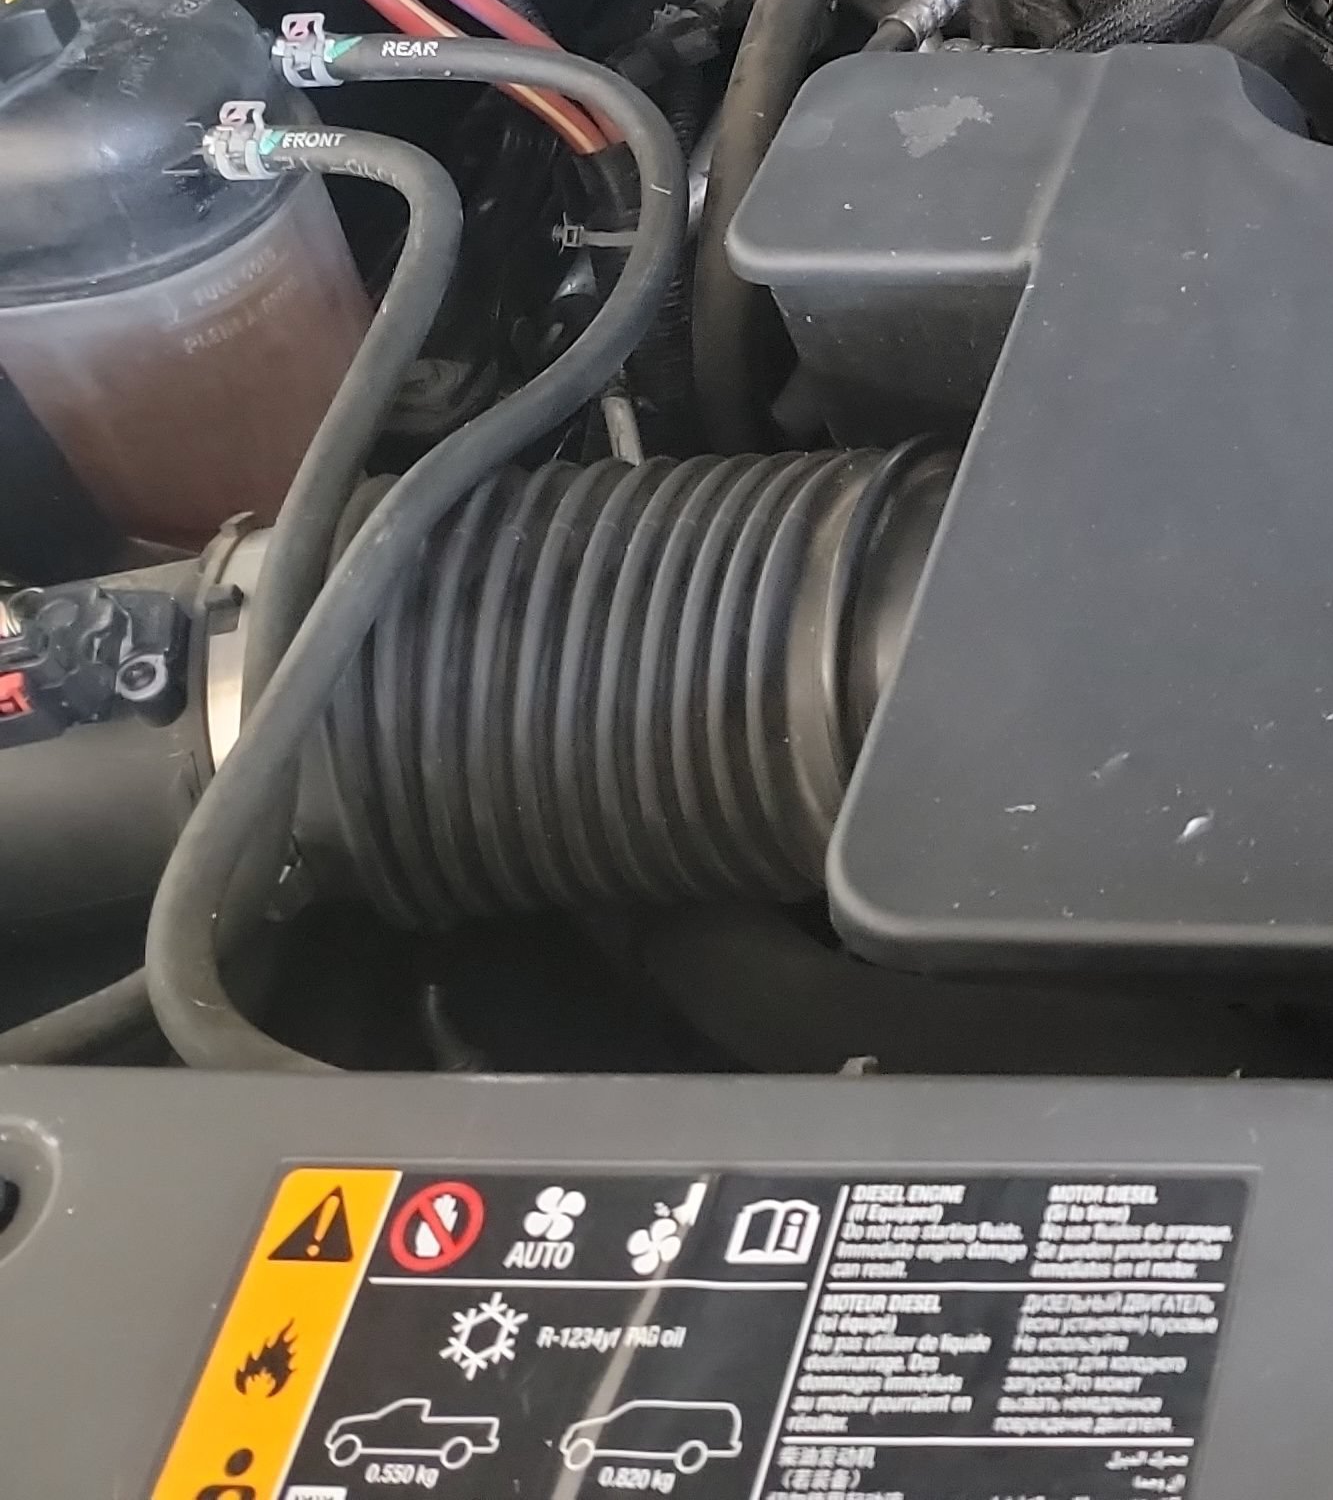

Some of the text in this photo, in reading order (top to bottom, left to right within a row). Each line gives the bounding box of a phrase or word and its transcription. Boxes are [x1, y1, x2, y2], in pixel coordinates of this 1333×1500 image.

[381, 41, 439, 58] REAR
[281, 131, 347, 149] FRONT
[852, 1185, 966, 1203] DIESEL ENGINE
[1049, 1185, 1158, 1204] MOTOR DIESEL
[842, 1222, 865, 1240] Do
[865, 1224, 892, 1240] not
[503, 1241, 575, 1270] AUTO
[830, 1263, 861, 1277] can
[821, 1294, 941, 1313] MOTEUR DIESEL
[626, 1326, 660, 1349] PAG
[660, 1326, 687, 1348] oil
[365, 1463, 439, 1489] 0.550 kg
[598, 1466, 675, 1494] 0.820 kg
